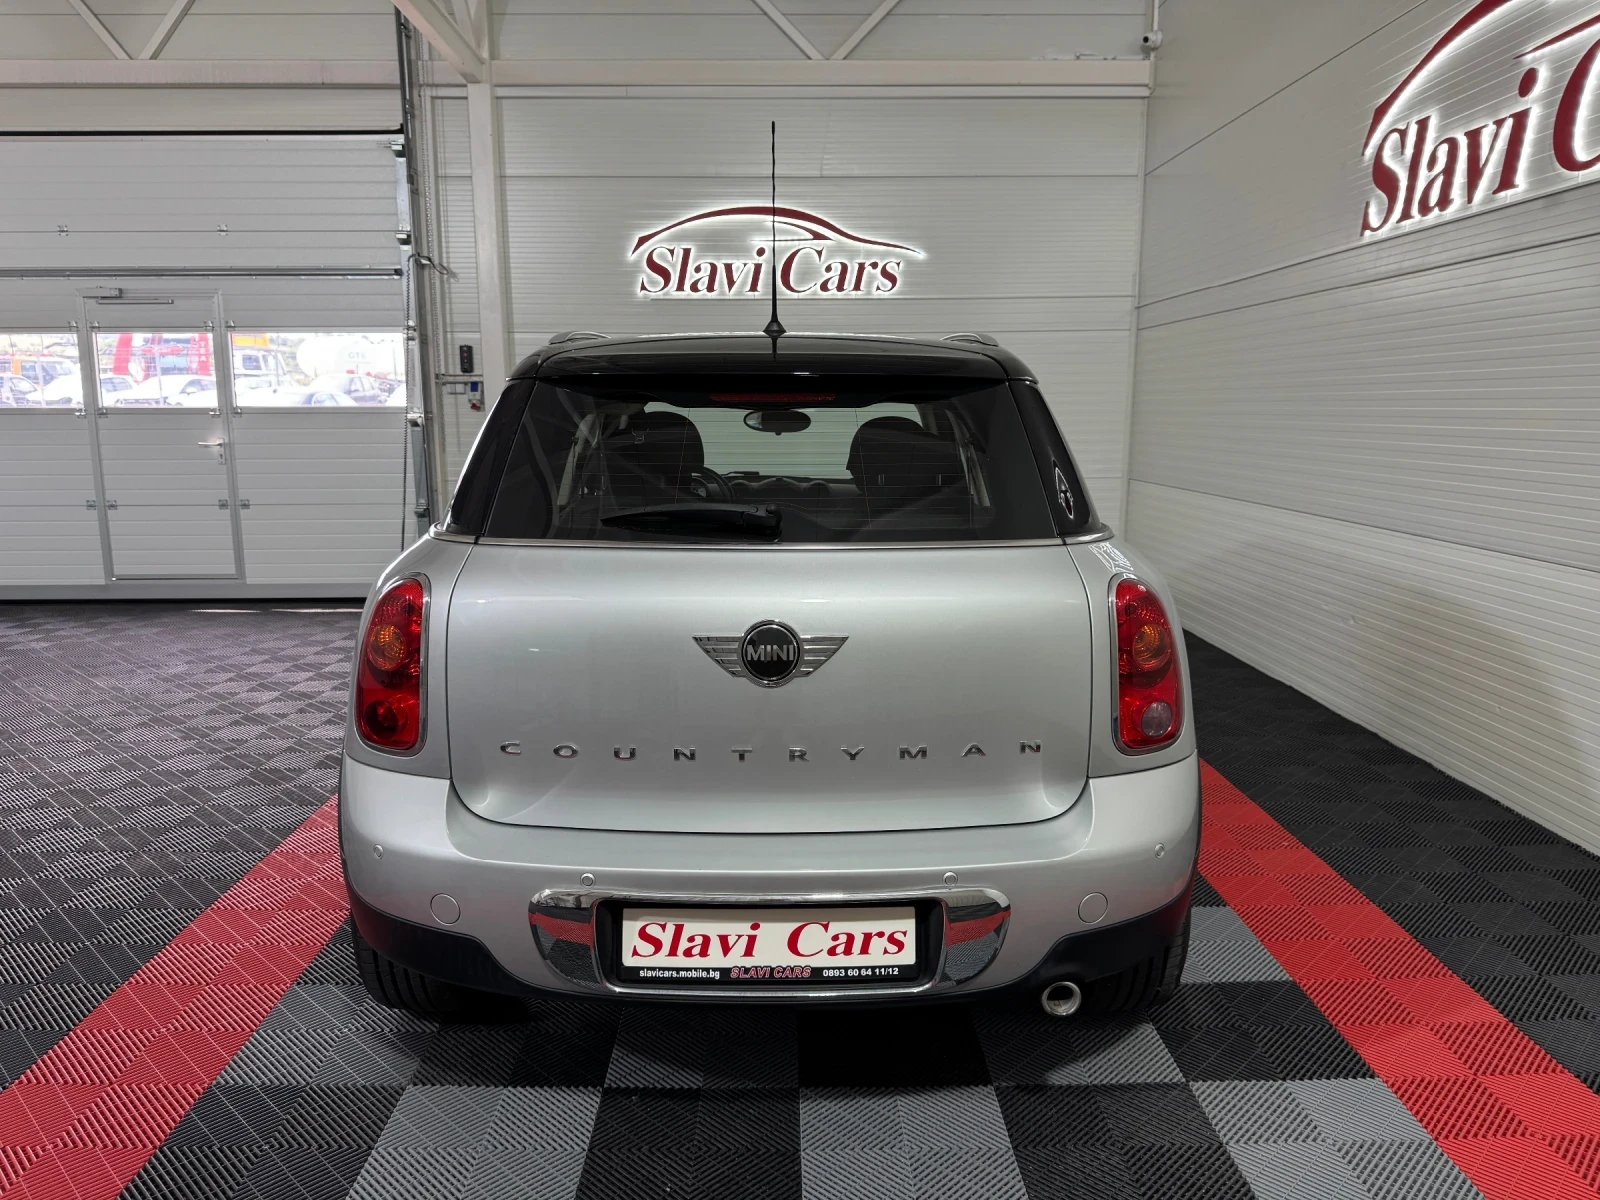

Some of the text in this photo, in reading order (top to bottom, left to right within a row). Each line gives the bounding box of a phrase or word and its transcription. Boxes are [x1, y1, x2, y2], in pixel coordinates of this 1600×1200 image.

[1359, 67, 1539, 237] Slavi
[639, 246, 902, 293] Slavi Cars
[746, 644, 794, 661] MINI
[500, 739, 1042, 763] COUNTRYMAN
[631, 920, 908, 958] Slavi Cars
[639, 968, 720, 980] slavicars.mobile.bg
[730, 966, 812, 979] SLAVI CARS
[822, 967, 899, 977] 0893 60 64 11/12
